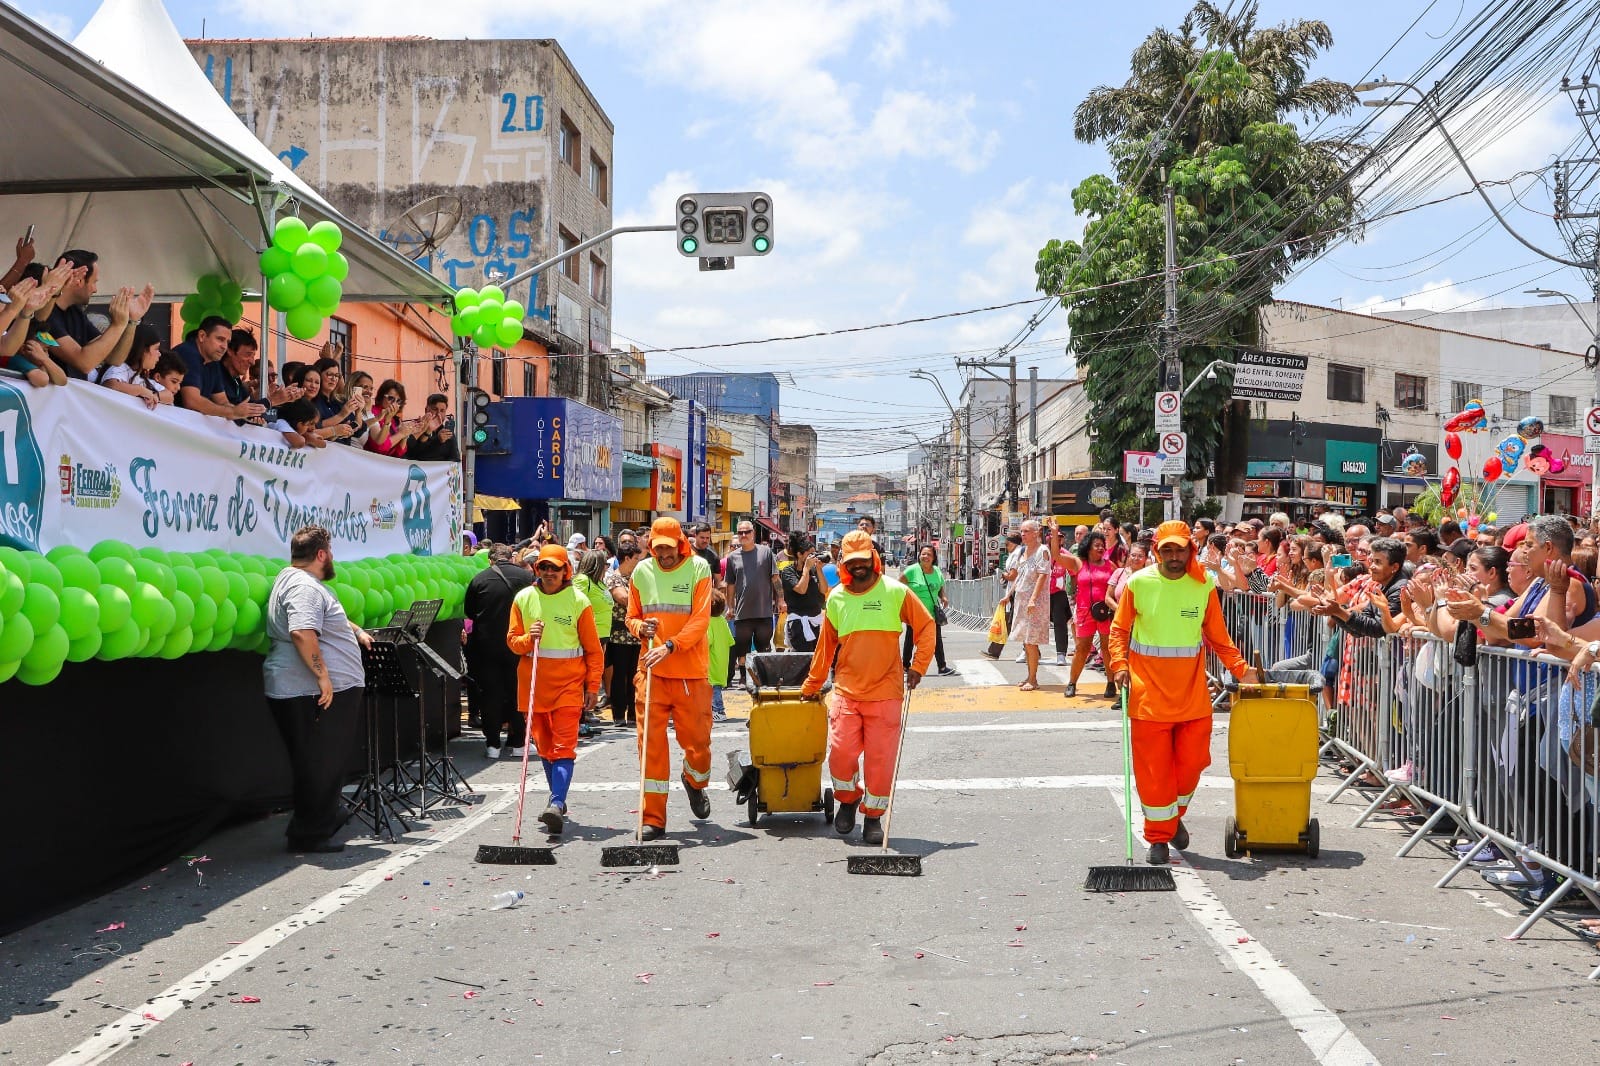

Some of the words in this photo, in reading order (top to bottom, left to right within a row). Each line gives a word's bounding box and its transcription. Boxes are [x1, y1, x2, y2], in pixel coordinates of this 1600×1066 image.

[501, 92, 544, 133] 2.0
[1241, 352, 1264, 363] ÁREA
[1265, 356, 1305, 367] RESTRITA
[1275, 370, 1305, 380] SOMENTE
[1235, 376, 1263, 386] VEÍCULOS
[1263, 380, 1303, 390] AUTORIZADOS
[537, 418, 545, 479] ÓTICAS
[552, 417, 561, 479] CAROL
[76, 463, 112, 491] FERRAZ
[129, 457, 219, 538] Ferraz
[227, 475, 258, 536] de
